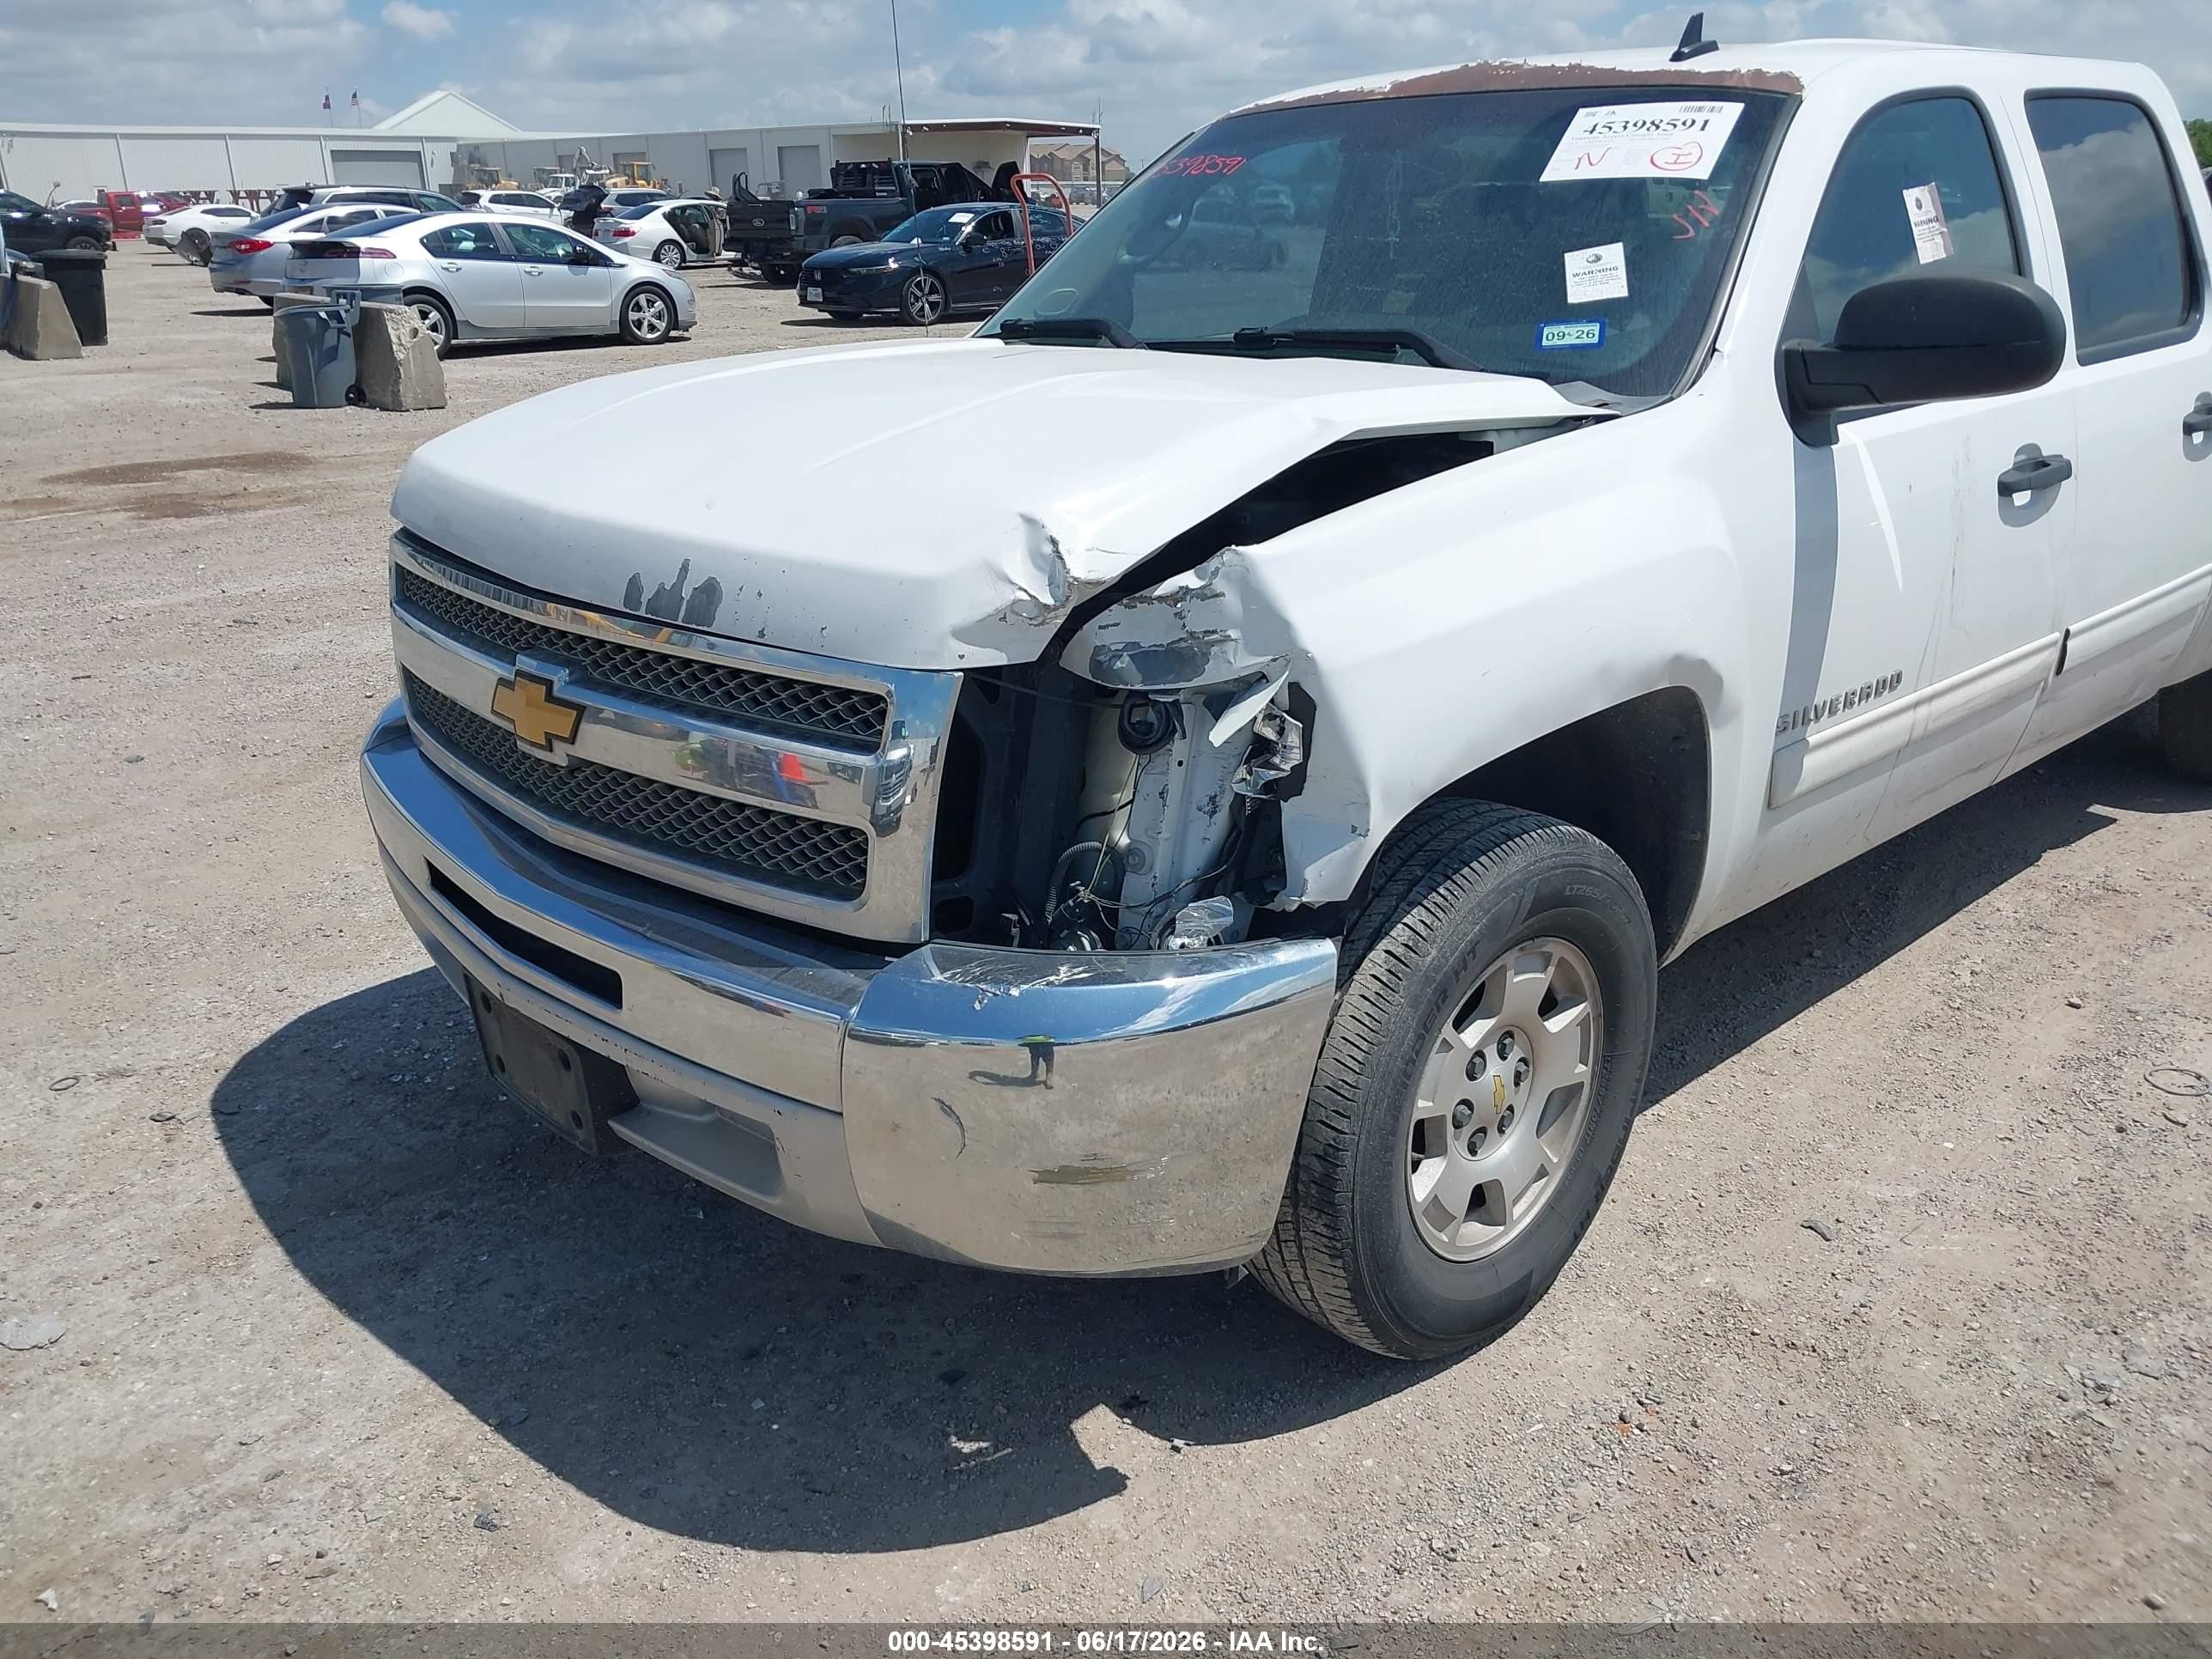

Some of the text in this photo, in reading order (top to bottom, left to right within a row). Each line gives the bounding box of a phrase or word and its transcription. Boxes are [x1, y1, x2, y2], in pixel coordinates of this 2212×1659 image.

[1583, 118, 1711, 135] 45398591
[1574, 146, 1613, 171] N
[1571, 265, 1620, 278] WARNING
[1775, 668, 1904, 736] SILVERADO
